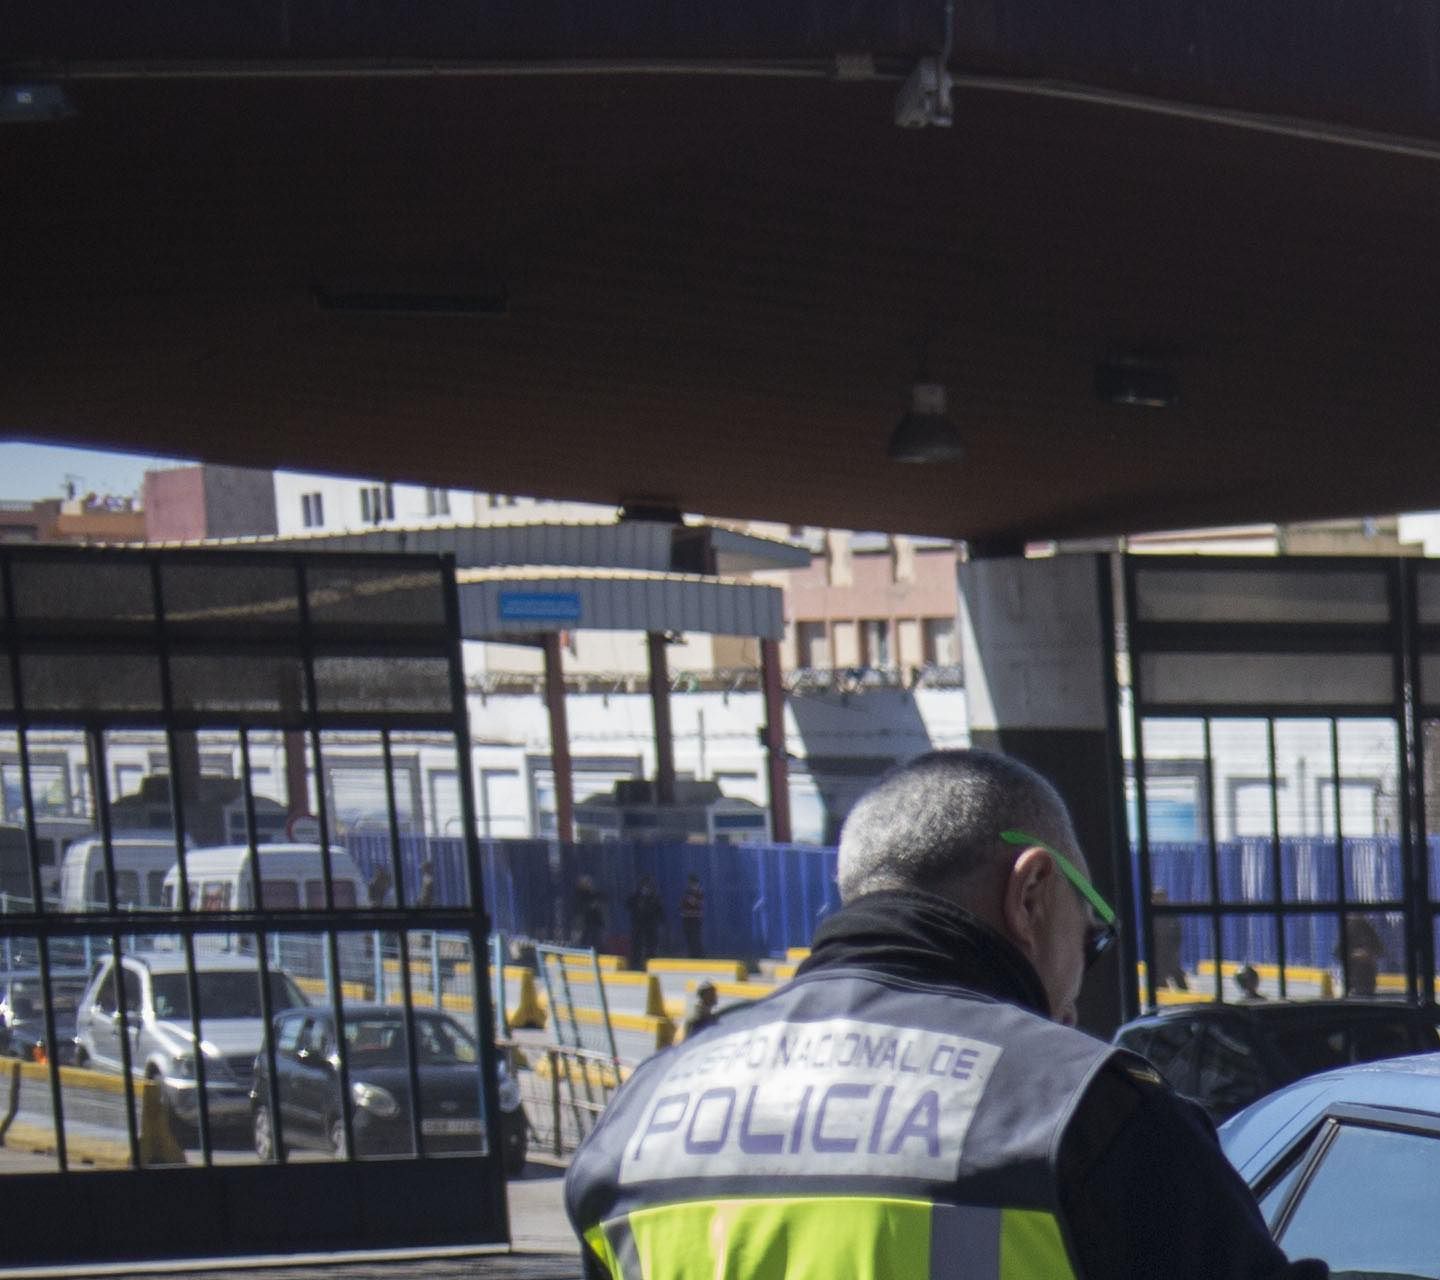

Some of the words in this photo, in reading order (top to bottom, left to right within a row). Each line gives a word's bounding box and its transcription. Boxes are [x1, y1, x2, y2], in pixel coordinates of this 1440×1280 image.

[770, 1032, 922, 1075] NACIONAL
[927, 1043, 981, 1080] DE
[633, 1081, 942, 1162] POLICIA
